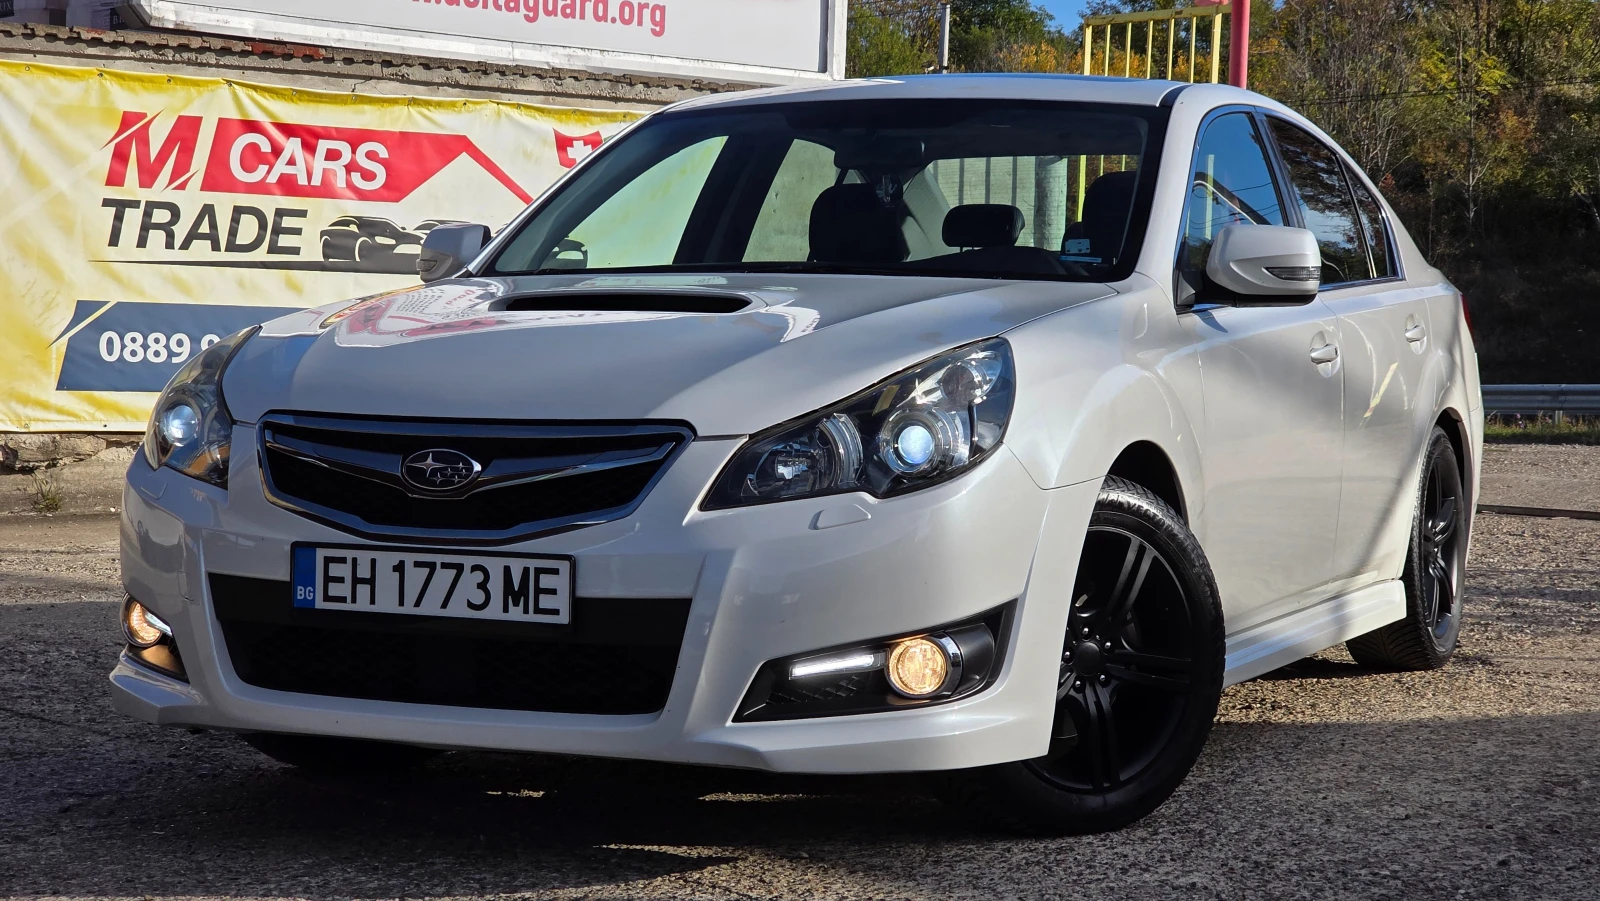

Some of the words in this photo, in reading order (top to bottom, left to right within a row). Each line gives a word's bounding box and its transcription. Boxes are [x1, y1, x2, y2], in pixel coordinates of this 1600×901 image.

[101, 109, 203, 192] M
[229, 132, 389, 190] CARS
[101, 198, 308, 256] TRADE
[99, 331, 191, 363] 0889
[297, 586, 314, 600] BG
[322, 555, 377, 606] EH
[392, 559, 492, 611] 1773
[502, 564, 561, 616] ME
